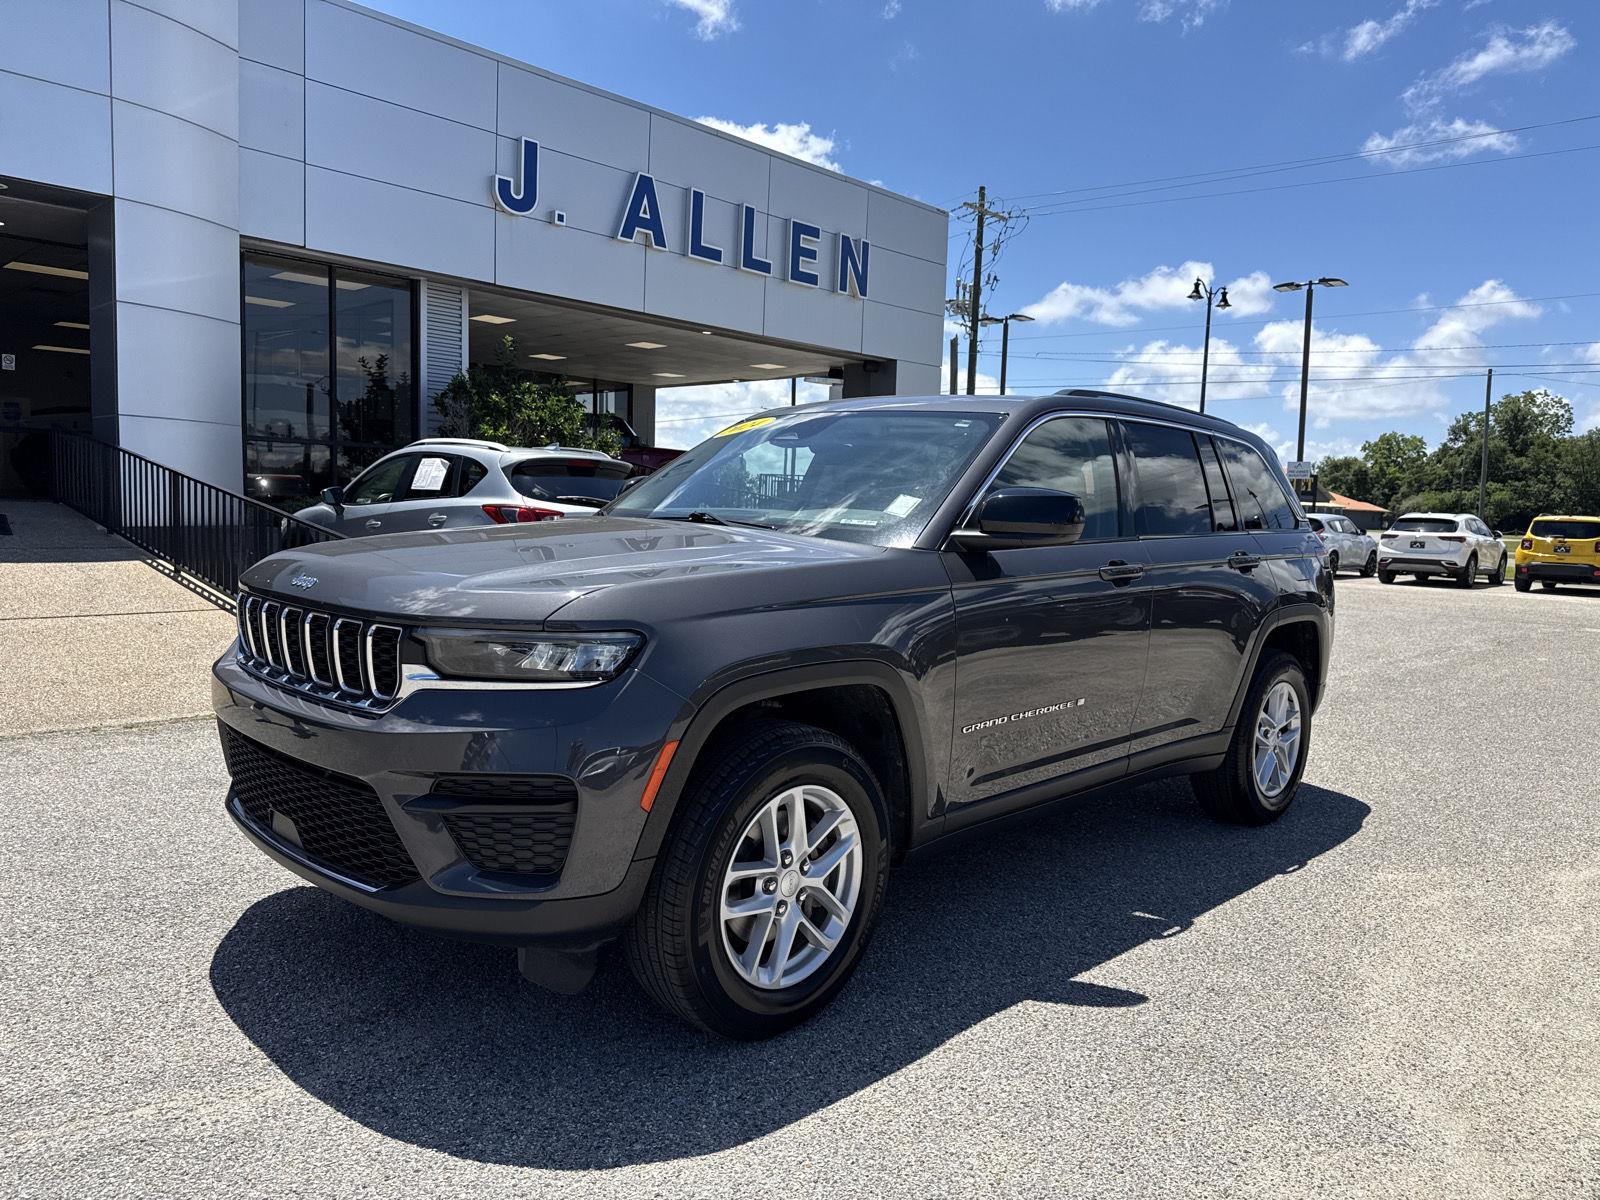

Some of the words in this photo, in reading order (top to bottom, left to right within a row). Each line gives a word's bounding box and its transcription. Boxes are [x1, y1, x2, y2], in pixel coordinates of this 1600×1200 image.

[492, 136, 567, 225] J.
[617, 171, 871, 299] ALLEN
[292, 573, 318, 590] Jeep
[962, 716, 1008, 734] GRAND
[1010, 700, 1076, 722] CHEROKEE
[704, 818, 737, 905] MICHELIN
